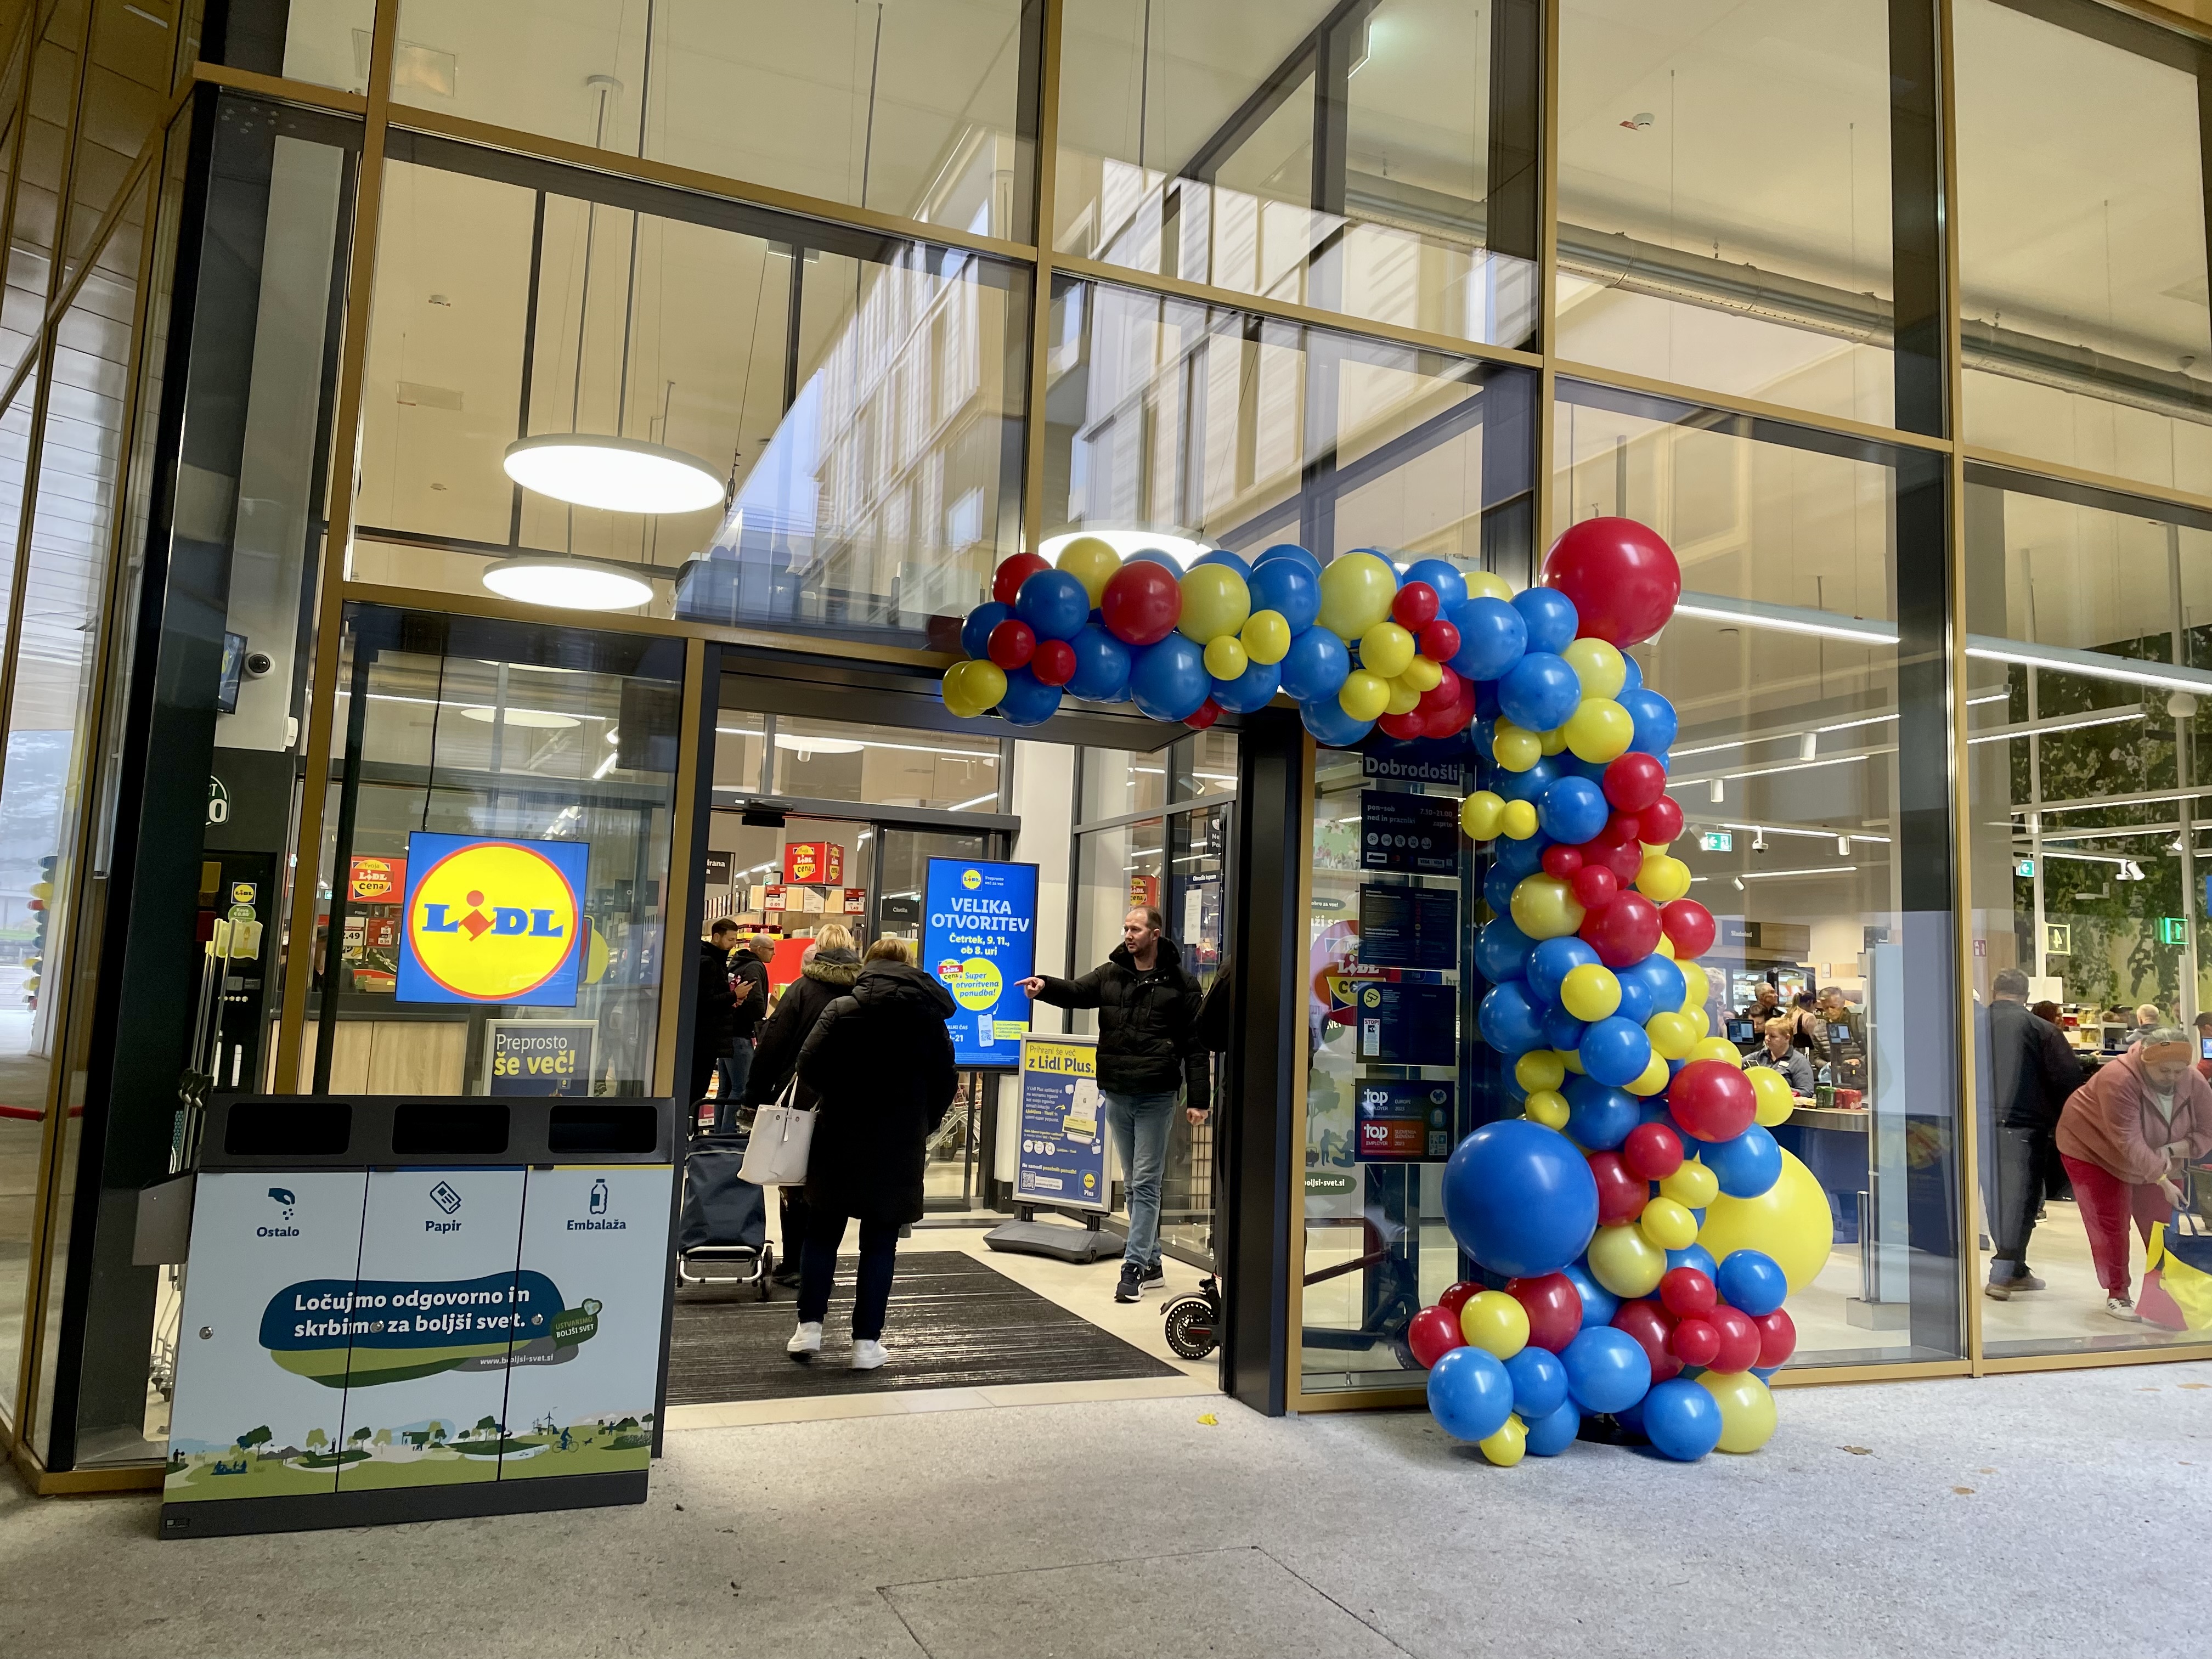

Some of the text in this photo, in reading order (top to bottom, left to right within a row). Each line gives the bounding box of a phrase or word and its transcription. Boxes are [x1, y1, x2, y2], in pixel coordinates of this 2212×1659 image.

[1365, 757, 1458, 781] Dobrodošli
[358, 870, 387, 881] LIDL
[951, 897, 1012, 915] VELIKA
[421, 890, 564, 943] LIDL
[931, 913, 1030, 932] OTVORITEV
[949, 933, 986, 945] Četrtek,
[987, 935, 995, 945] 9.
[961, 945, 998, 956] ob 8. uri
[1337, 955, 1379, 976] LIDL
[956, 980, 999, 989] otvoritvena
[960, 989, 996, 998] ponudba!
[495, 1034, 567, 1054] Preprosto
[1029, 1045, 1054, 1055] Prihrani
[1064, 1048, 1076, 1057] več
[494, 1049, 575, 1076] še več!
[1029, 1056, 1094, 1074] z Lidl Plus.
[1363, 1088, 1389, 1106] top
[1363, 1123, 1389, 1141] top
[256, 1226, 300, 1238] Ostalo
[425, 1220, 462, 1234] Papir
[567, 1218, 627, 1231] Embalaža
[295, 1286, 529, 1313] Ločujmo odgovorno in
[294, 1313, 526, 1337] skrbim za boljši svet.
[555, 1317, 593, 1330] USTVARIMO
[556, 1323, 595, 1338] BOLJŠI SVET
[480, 1353, 554, 1365] www.boljsi-svet.si
